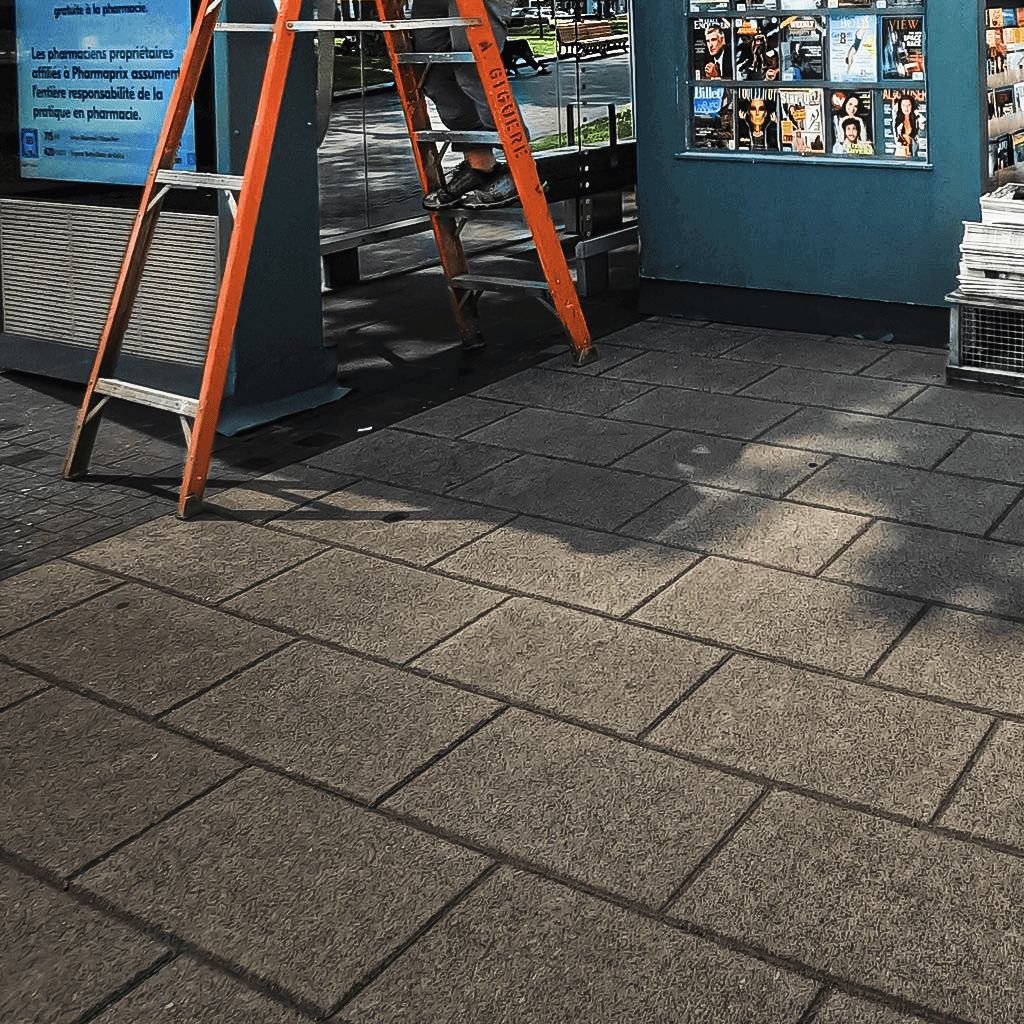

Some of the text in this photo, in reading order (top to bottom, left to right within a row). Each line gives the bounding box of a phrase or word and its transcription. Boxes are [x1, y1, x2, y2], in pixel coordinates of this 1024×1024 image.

[54, 2, 149, 19] gratuite à la pharmacie.
[888, 19, 919, 30] VIEW
[31, 45, 175, 62] Les pharmaciens propriétaires
[31, 65, 180, 83] affiliés à Pharmaprix assument
[32, 85, 164, 102] l'entière responsabilité de la
[32, 105, 143, 122] pratique en pharmacie.
